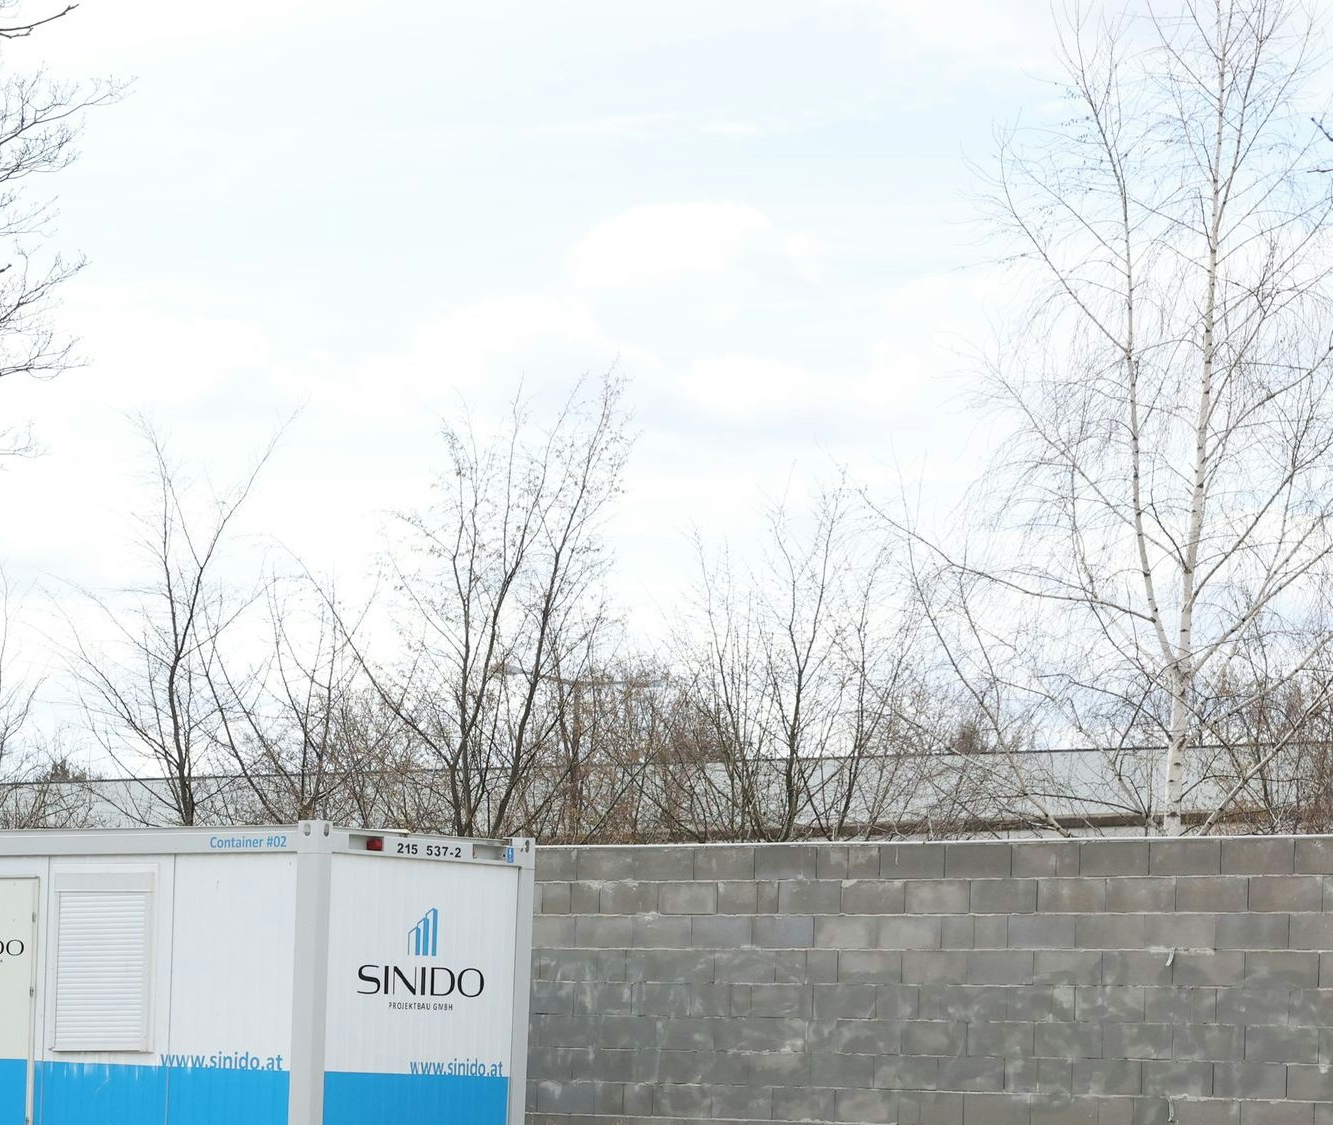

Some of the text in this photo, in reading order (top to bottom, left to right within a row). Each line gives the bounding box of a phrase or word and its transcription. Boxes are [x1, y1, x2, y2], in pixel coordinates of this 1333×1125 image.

[209, 835, 288, 849] Container #02
[397, 843, 463, 859] 215 537-2
[356, 964, 485, 998] SINIDO
[388, 1001, 453, 1011] PROJEKTBAU GMBH
[160, 1050, 283, 1070] www.sinido.at
[410, 1057, 503, 1077] www.sinido.at
